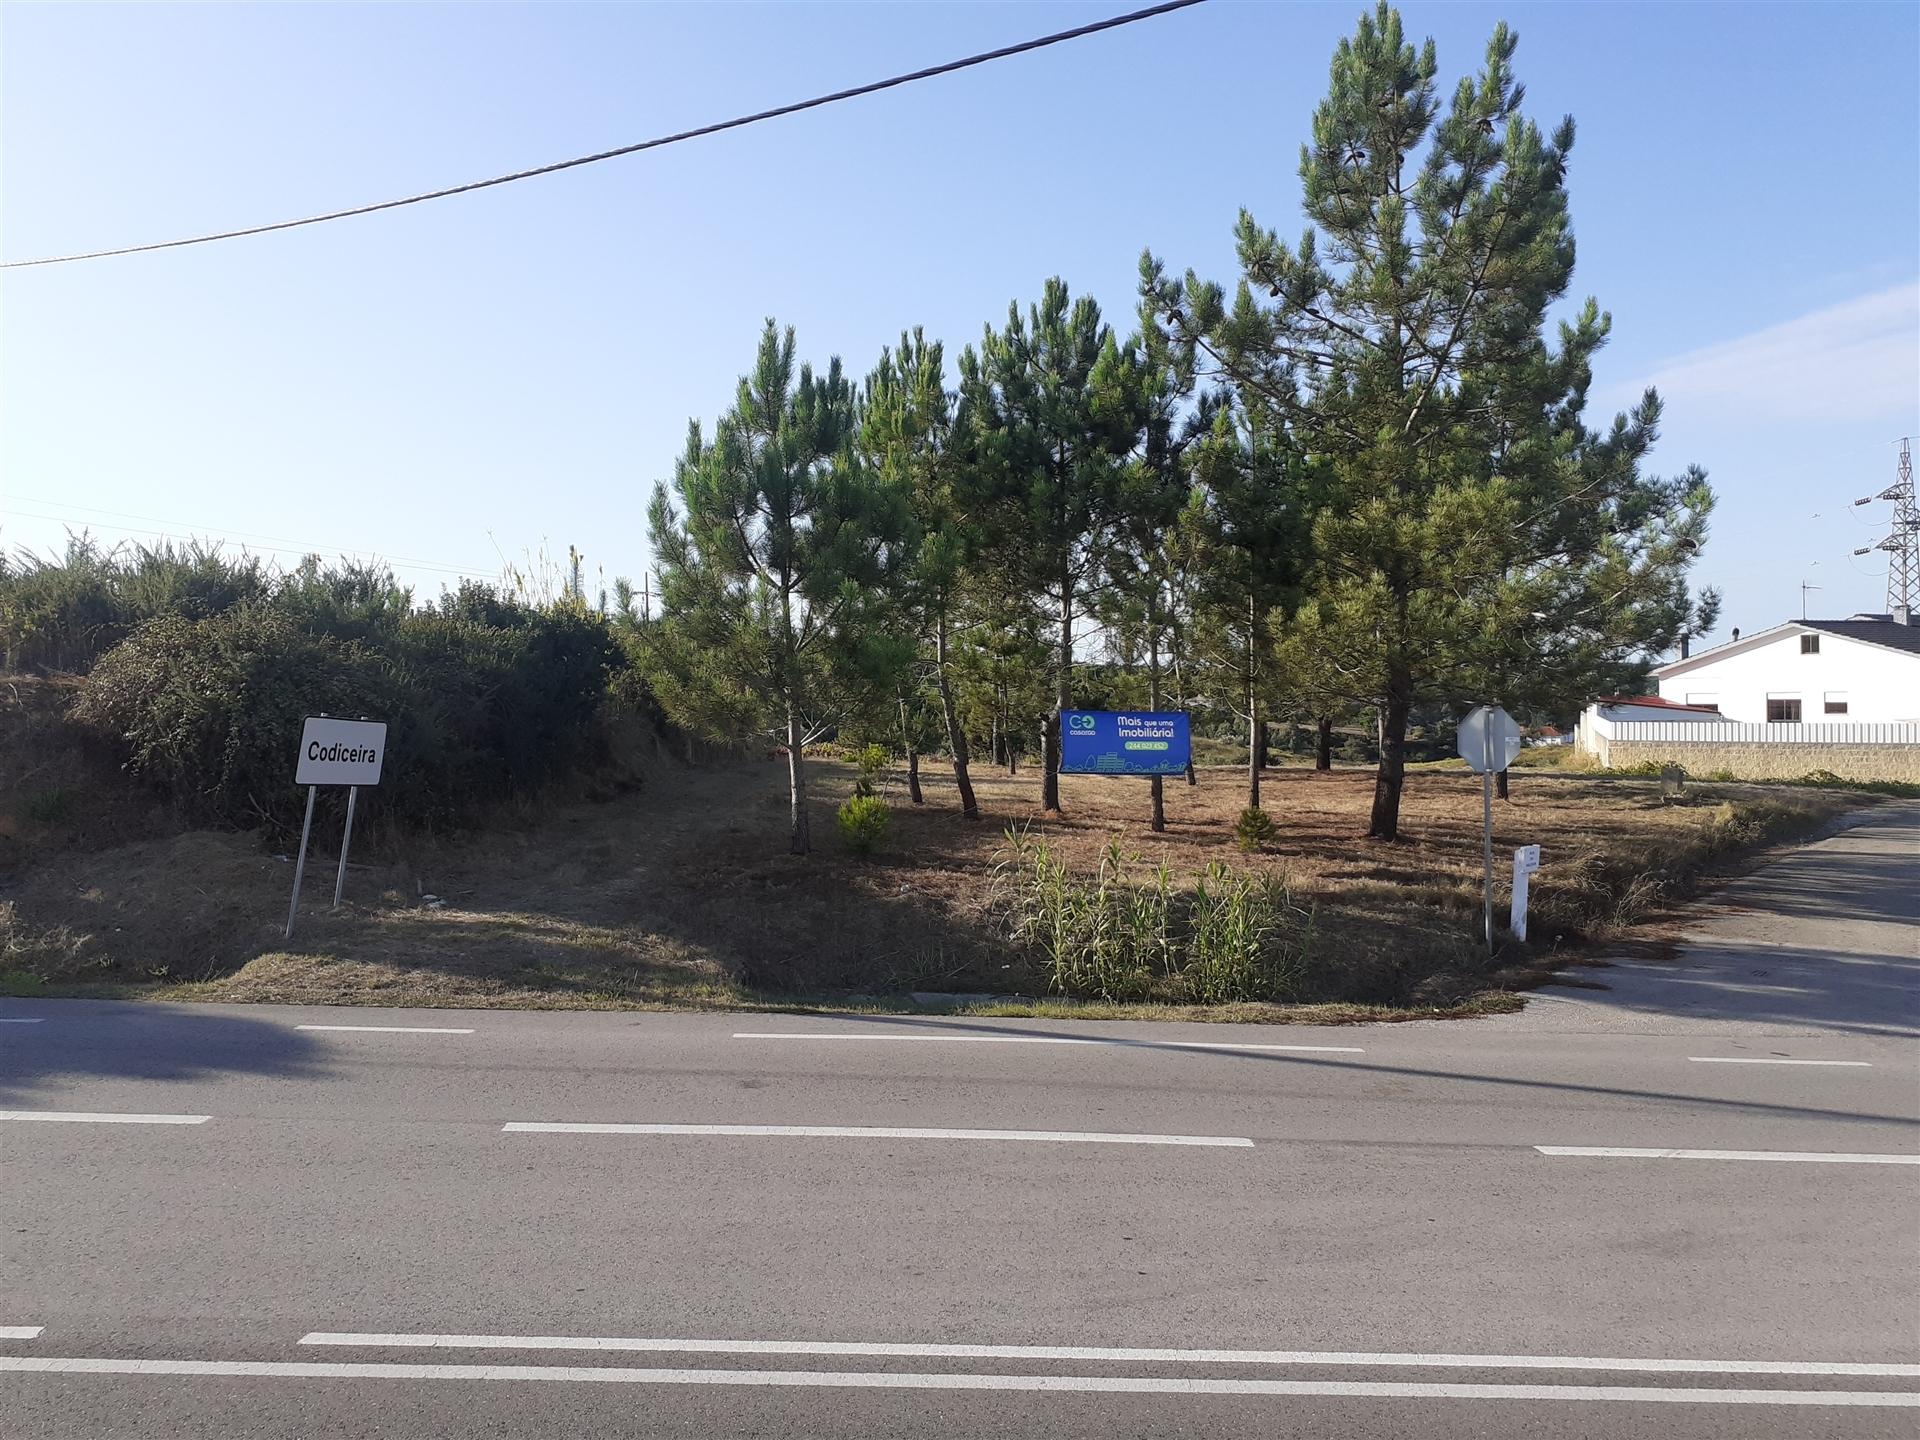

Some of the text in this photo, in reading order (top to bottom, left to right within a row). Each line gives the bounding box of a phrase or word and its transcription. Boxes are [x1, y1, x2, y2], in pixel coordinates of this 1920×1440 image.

[1117, 716, 1142, 726] Mais
[1144, 720, 1157, 728] que
[1118, 727, 1174, 738] Imobiliária!
[308, 741, 376, 763] Codiceira
